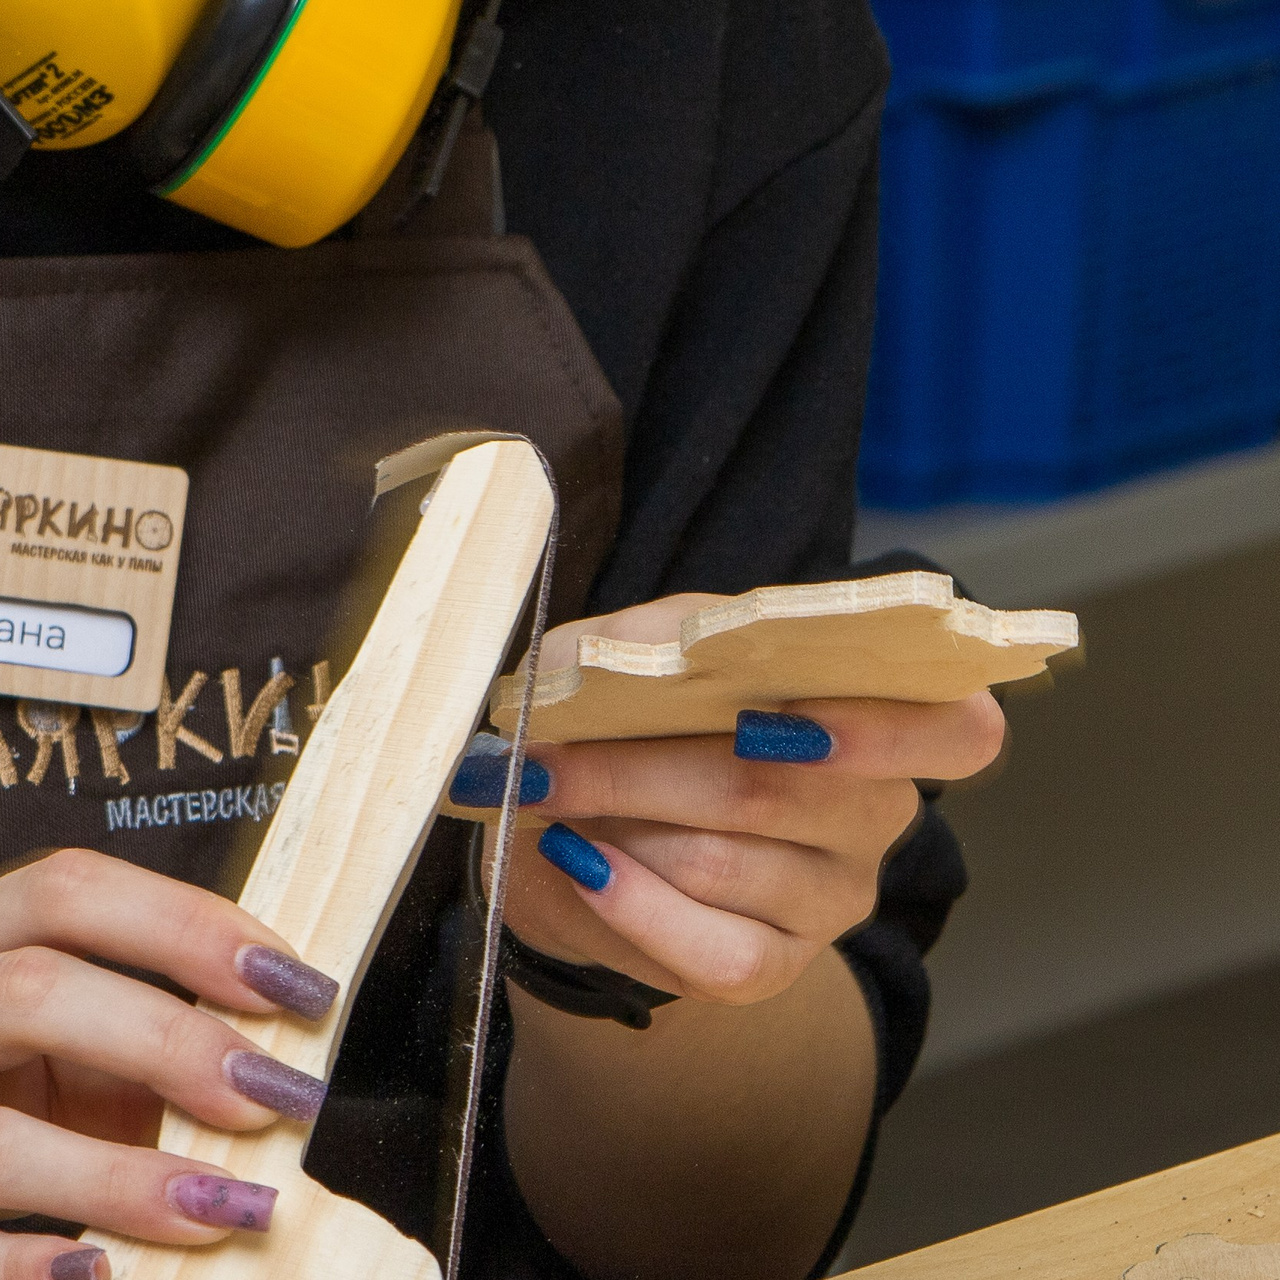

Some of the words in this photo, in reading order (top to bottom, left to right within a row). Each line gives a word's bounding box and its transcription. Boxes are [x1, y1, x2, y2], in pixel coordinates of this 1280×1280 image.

[11, 542, 88, 564] МАСТЕРСКАЯ
[91, 552, 114, 568] КАК
[117, 557, 126, 569] У
[128, 556, 164, 573] ПАПЫ
